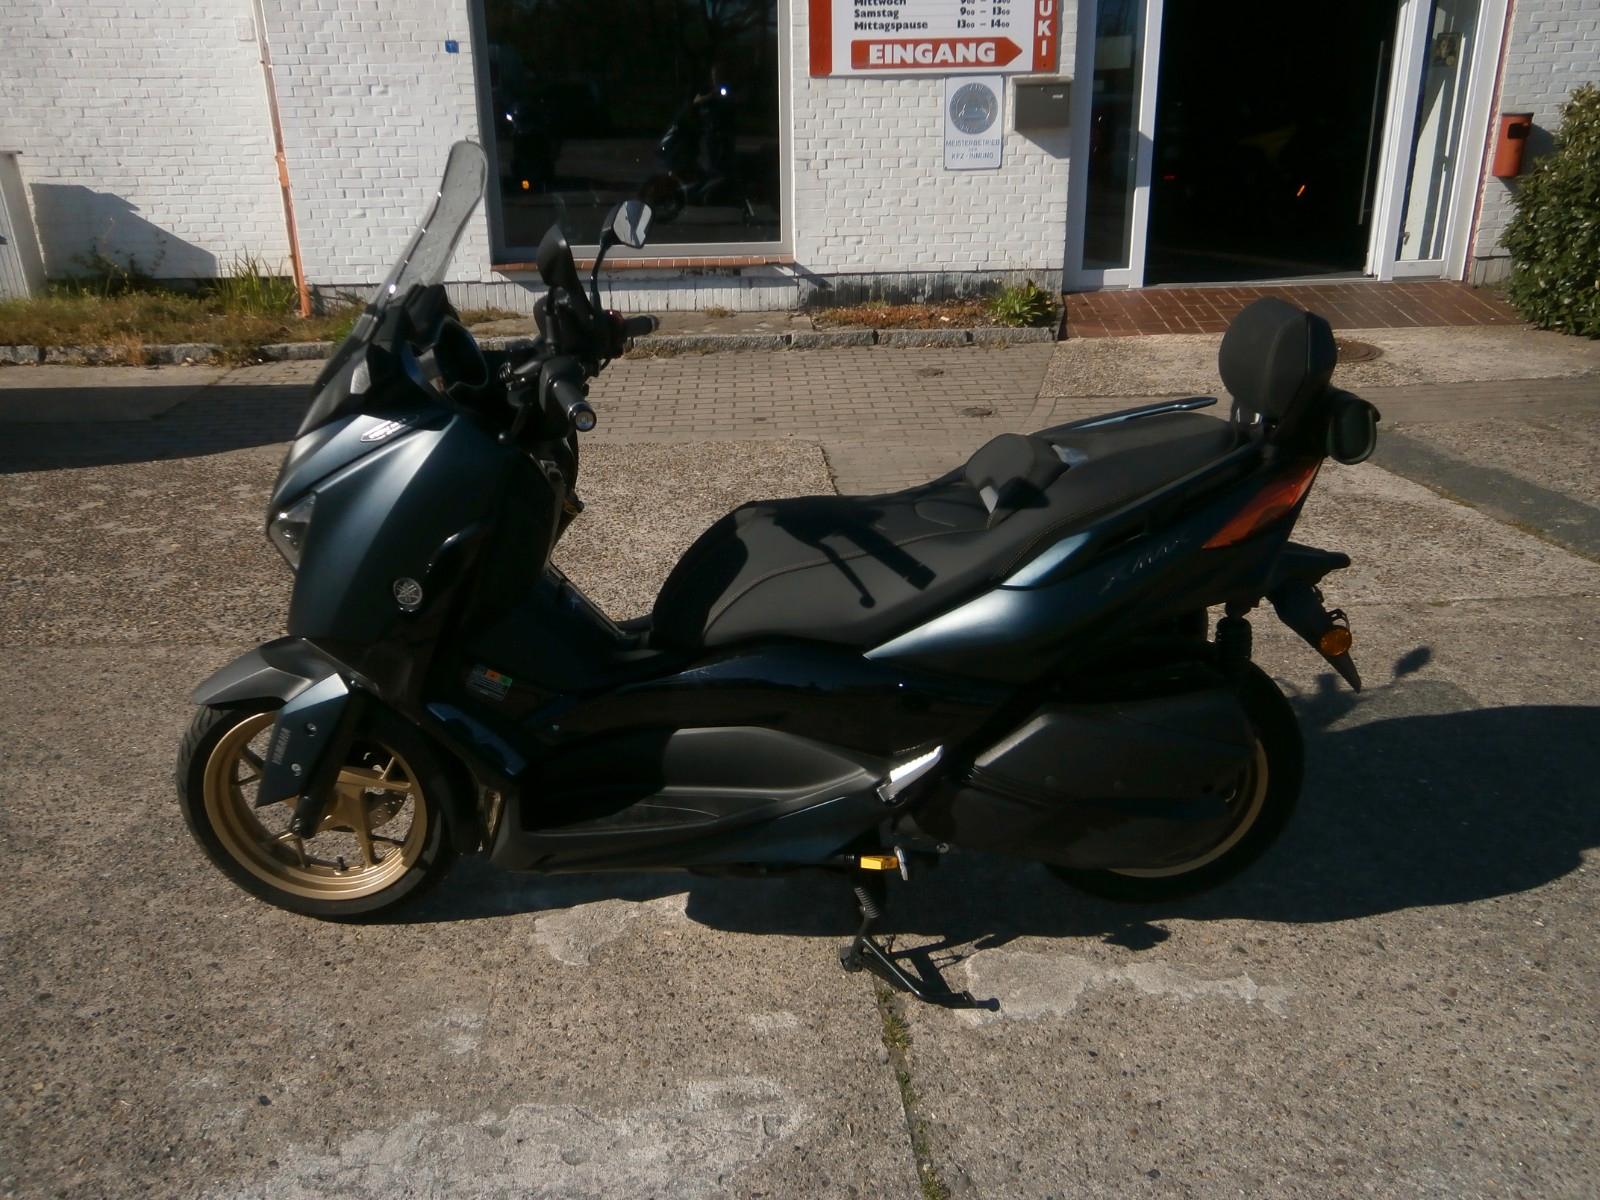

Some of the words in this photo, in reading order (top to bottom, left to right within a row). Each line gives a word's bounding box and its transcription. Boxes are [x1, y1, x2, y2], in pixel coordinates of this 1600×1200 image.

[854, 9, 899, 19] Samstag
[854, 21, 928, 32] Mittagspause
[869, 42, 995, 64] EINGANG
